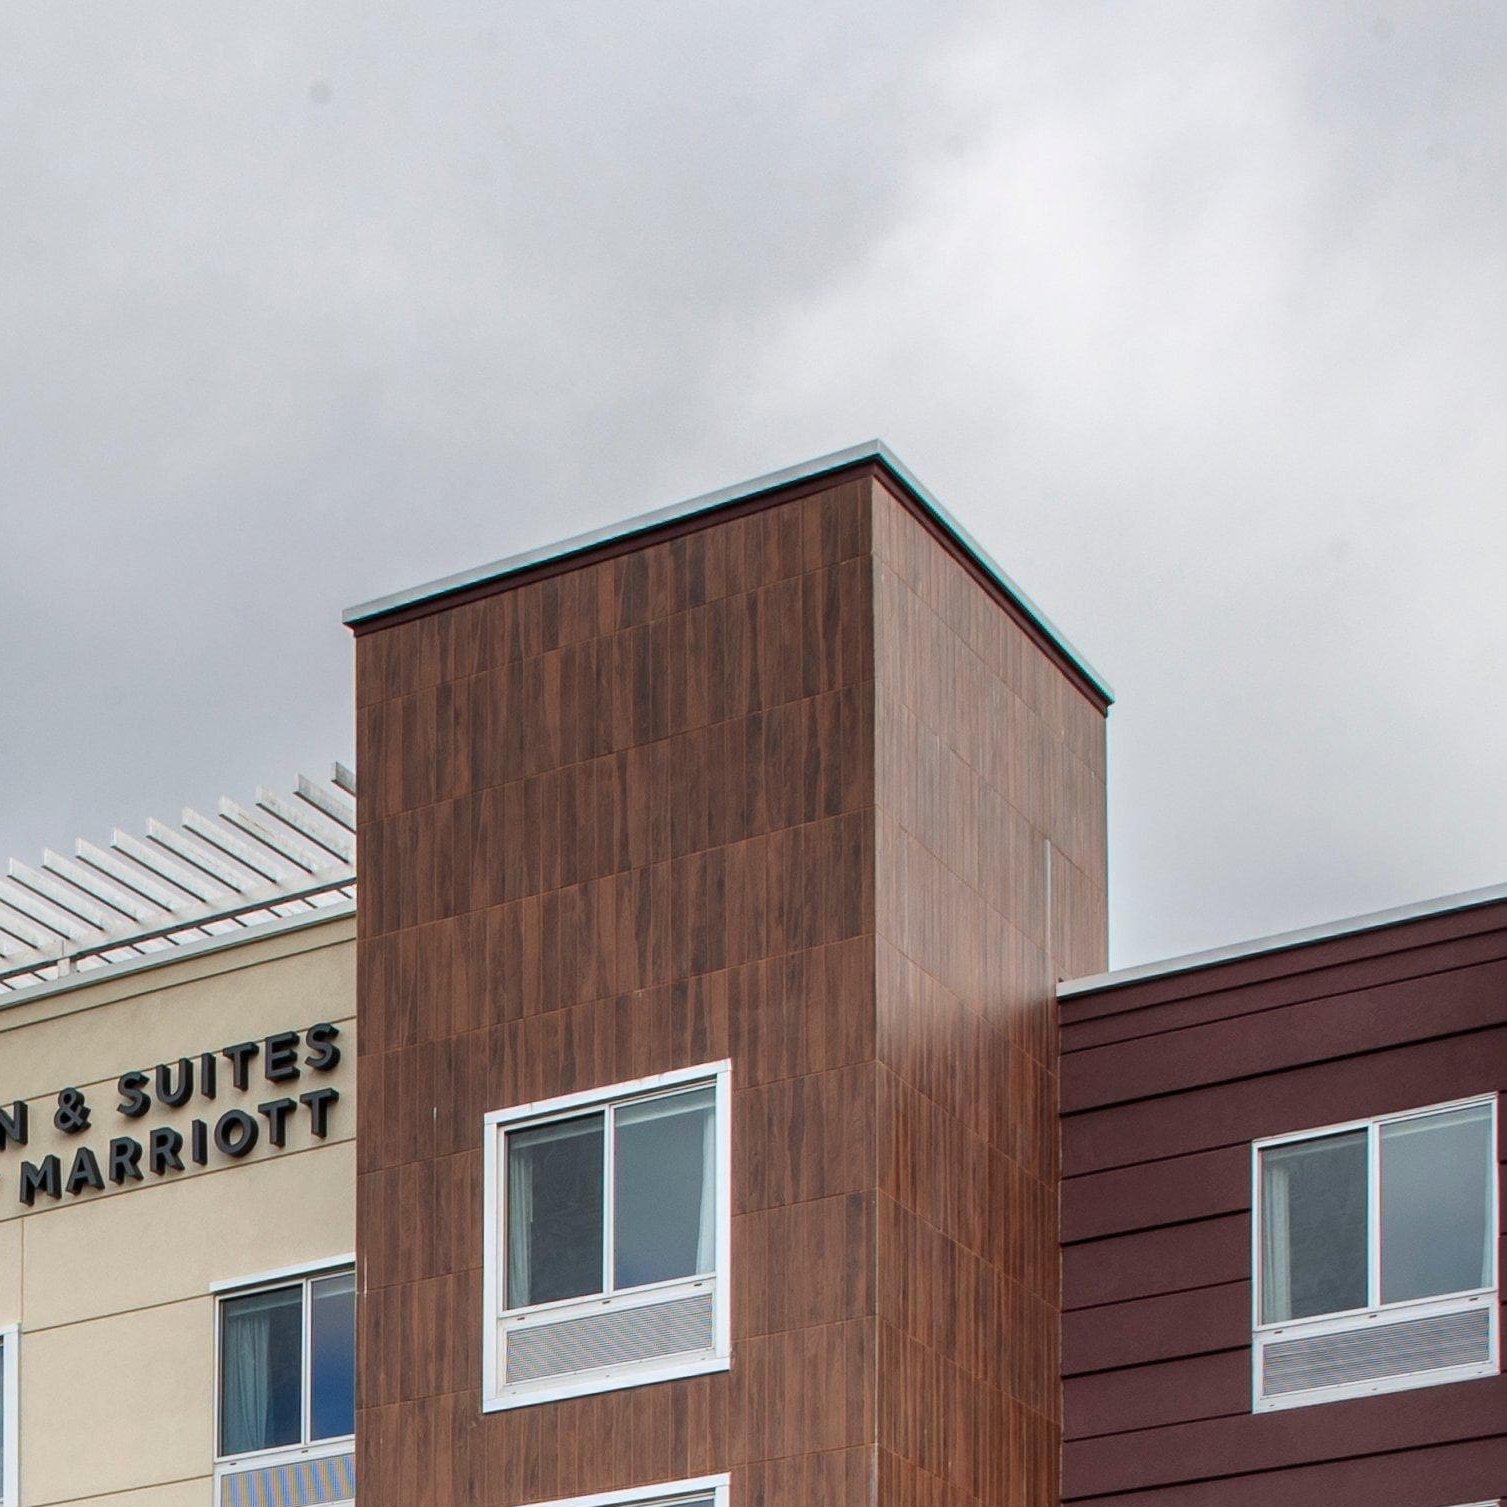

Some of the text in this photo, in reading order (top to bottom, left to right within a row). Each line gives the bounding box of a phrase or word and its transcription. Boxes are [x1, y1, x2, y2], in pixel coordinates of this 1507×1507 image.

[54, 1086, 92, 1134] &
[116, 1022, 342, 1119] SUITES
[19, 1087, 340, 1207] MARRIOTT
